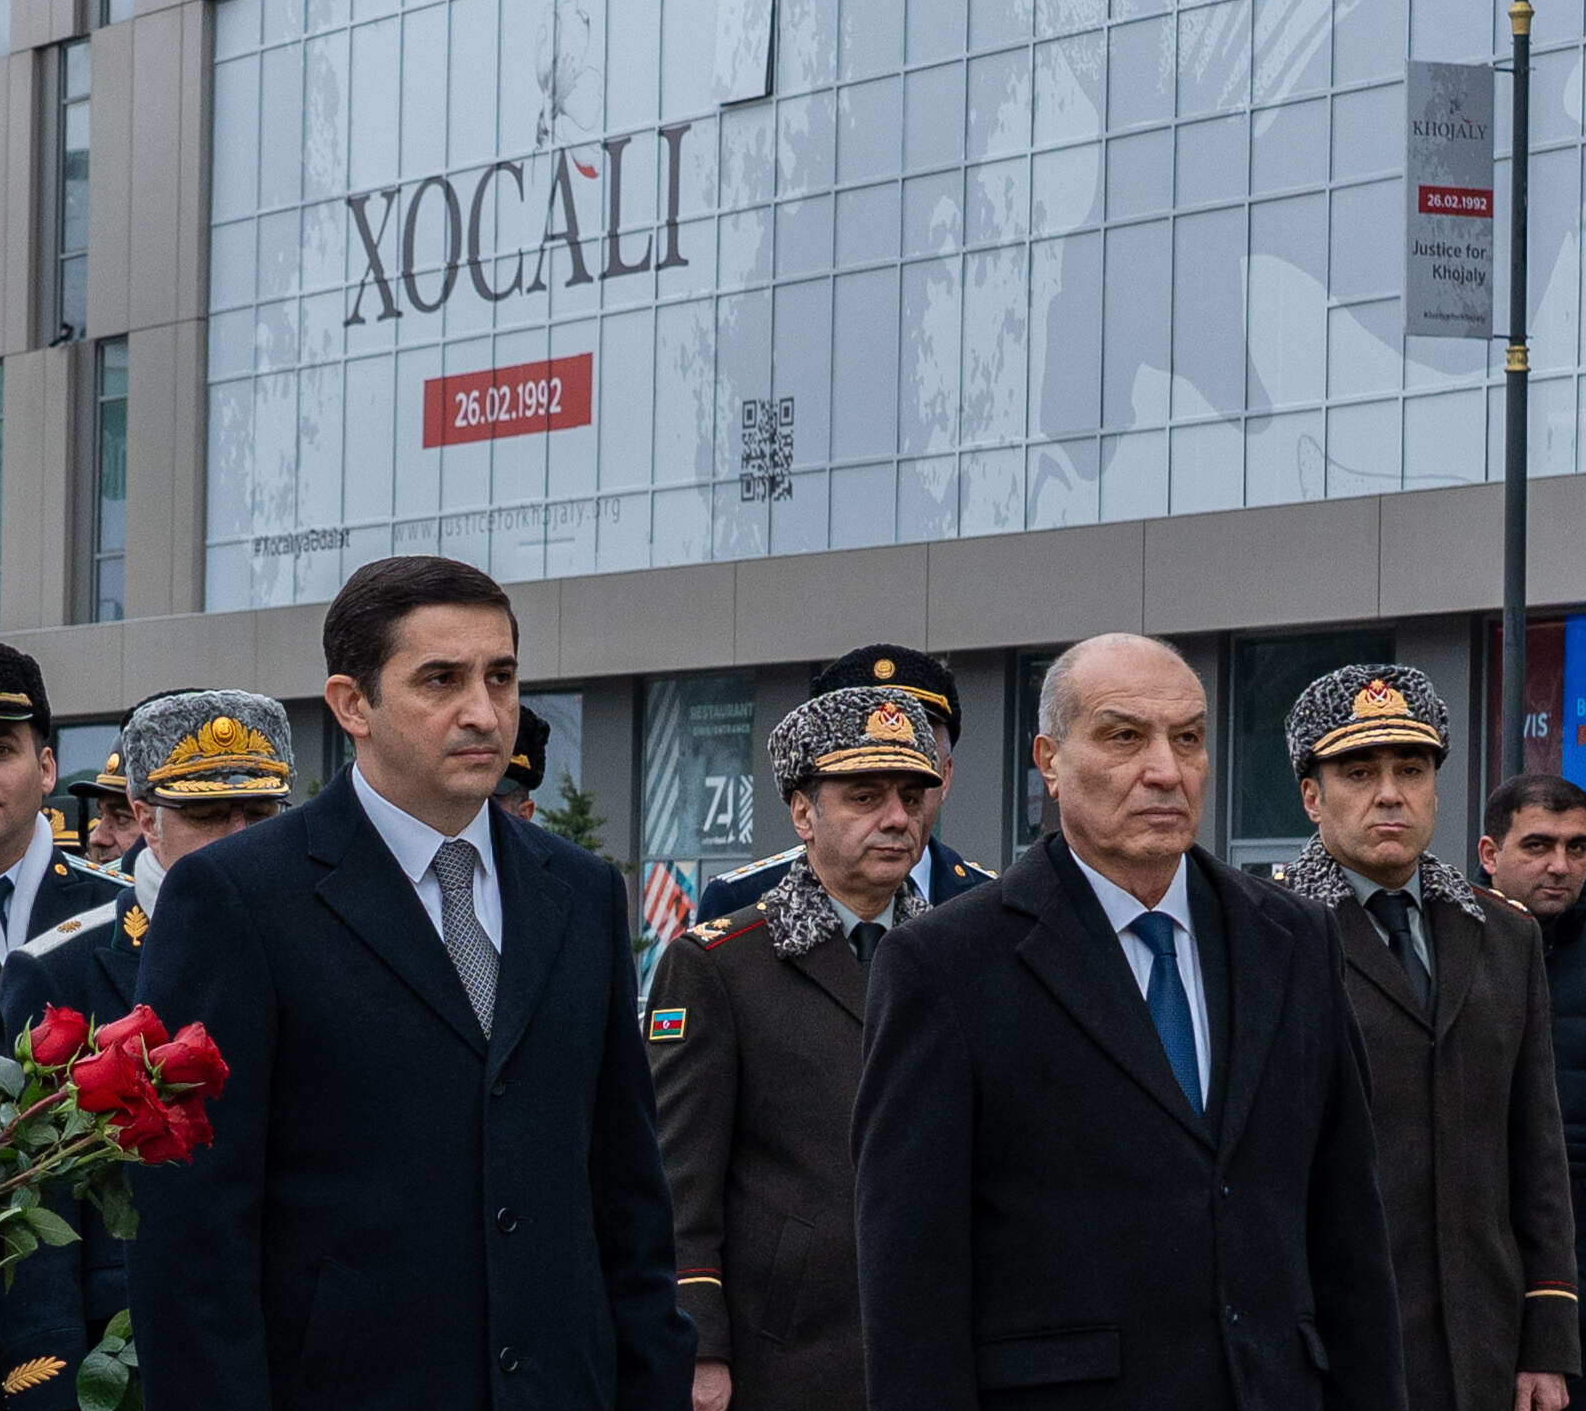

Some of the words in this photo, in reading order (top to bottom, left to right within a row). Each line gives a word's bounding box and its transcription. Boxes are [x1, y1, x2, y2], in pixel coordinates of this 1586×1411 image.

[1412, 121, 1487, 141] KHOJALY
[1427, 194, 1487, 210] 26.02.1992
[343, 124, 692, 326] XOCALI
[1412, 238, 1462, 258] Justice
[1466, 243, 1486, 259] for
[1432, 264, 1486, 286] Khojaly
[454, 378, 563, 428] 26.02.1992
